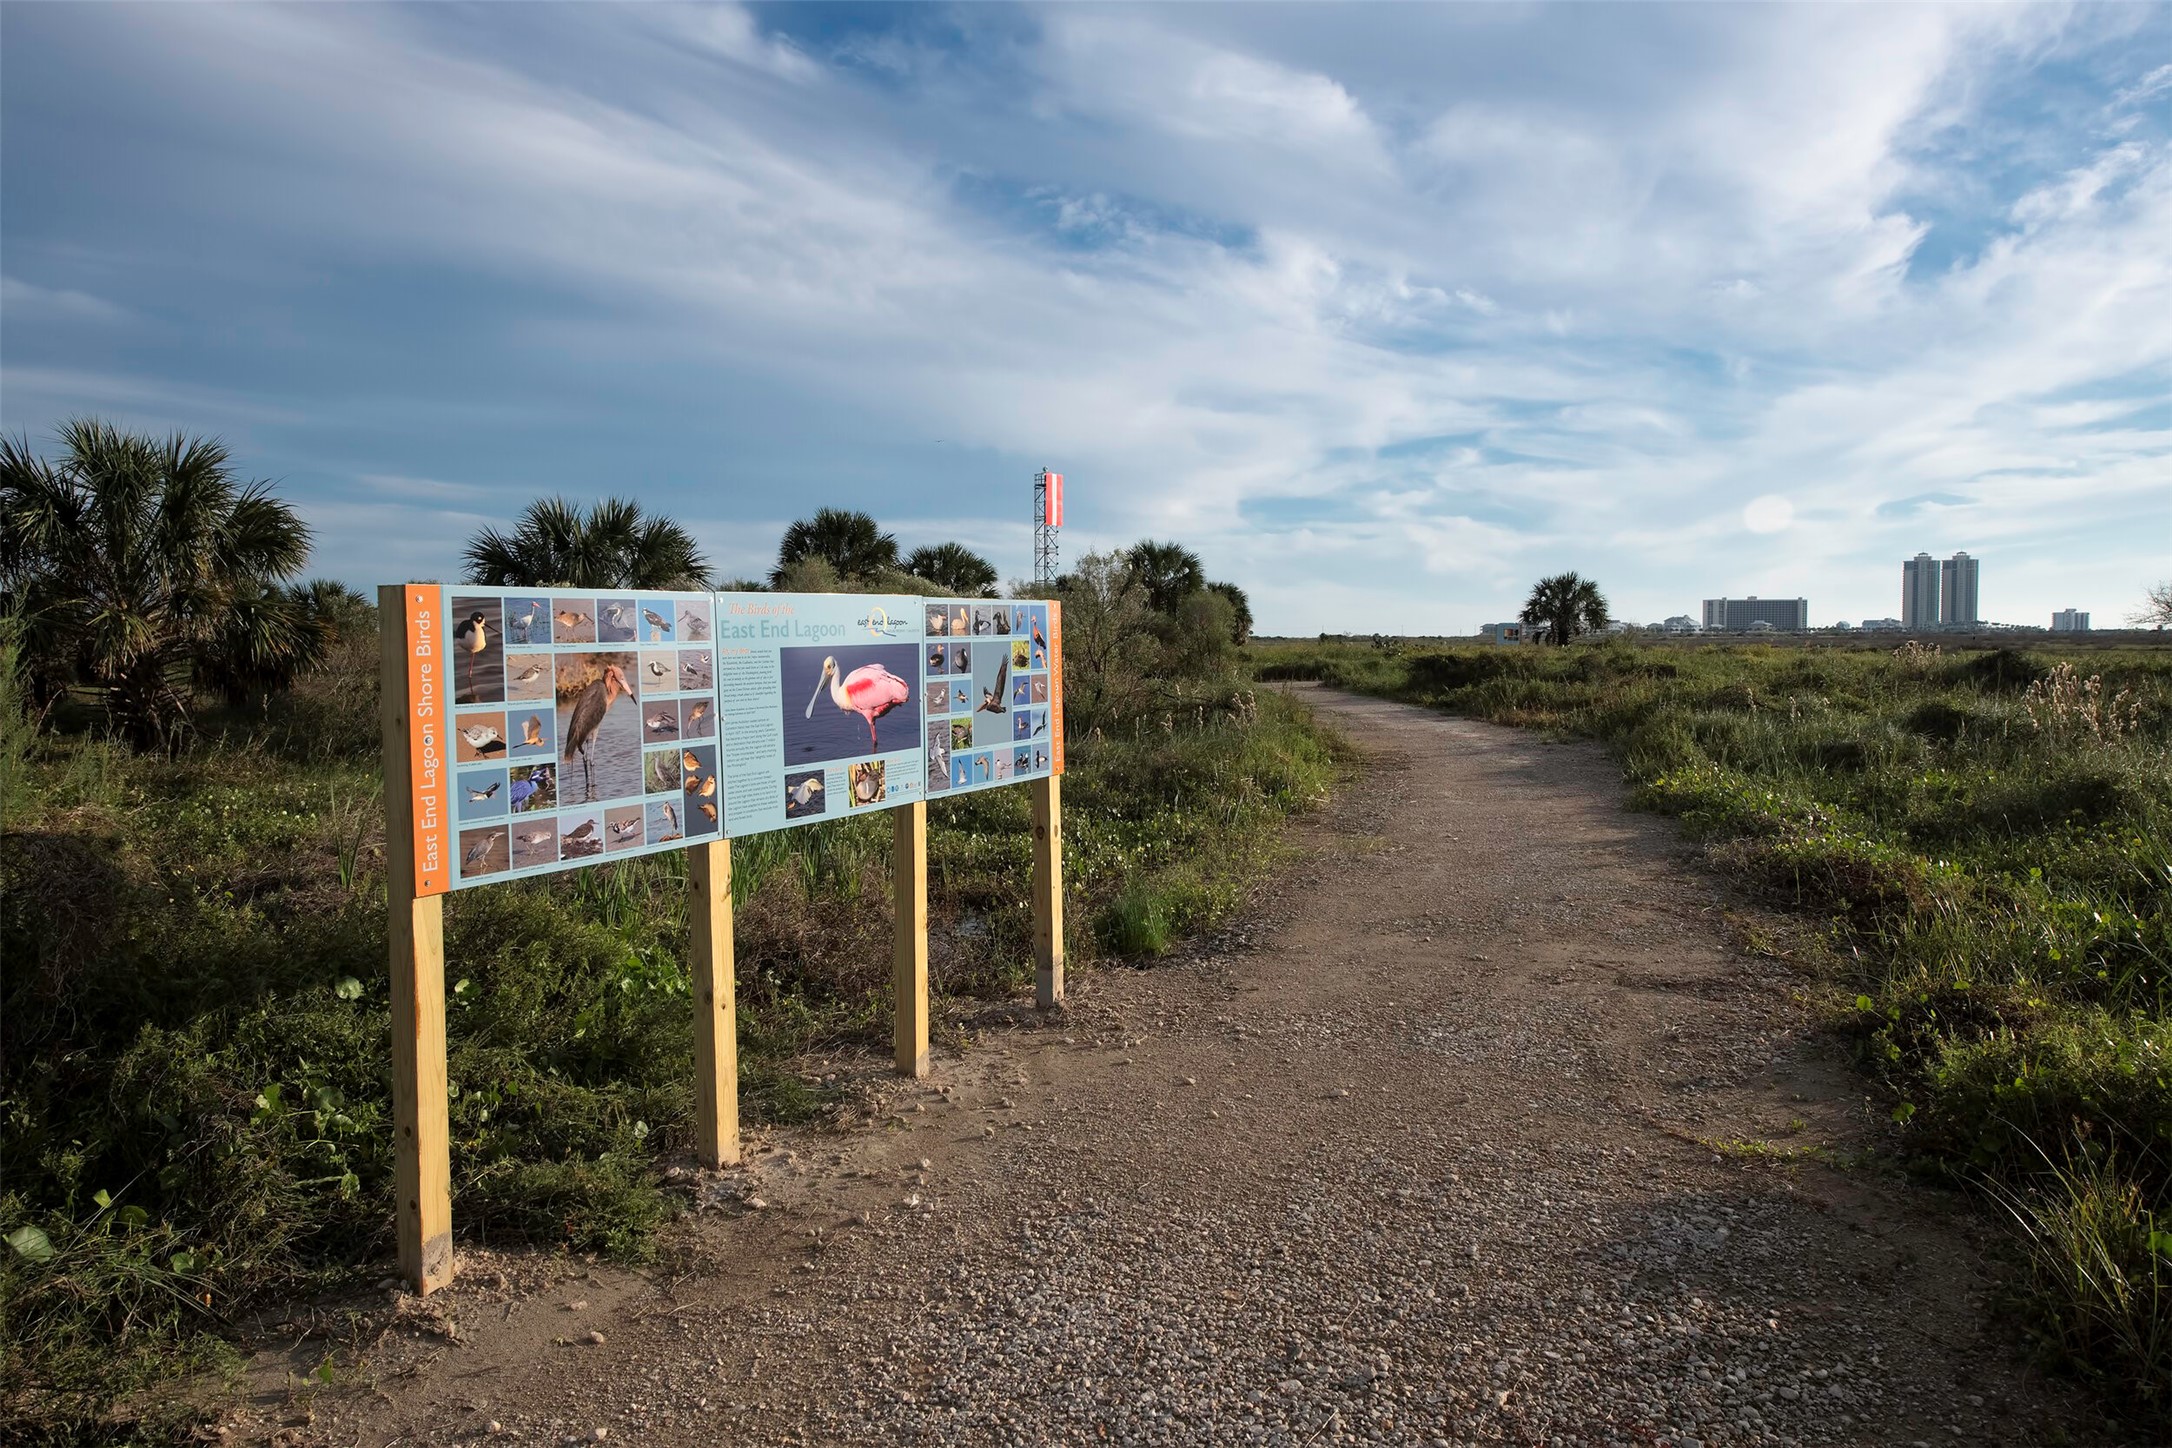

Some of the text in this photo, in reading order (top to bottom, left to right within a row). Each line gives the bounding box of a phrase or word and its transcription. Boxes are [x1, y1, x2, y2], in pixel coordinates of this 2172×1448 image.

[729, 602, 795, 617] The Birds of the
[720, 619, 846, 642] East End Lagoon
[415, 610, 439, 872] East End Lagoon Shore Birds
